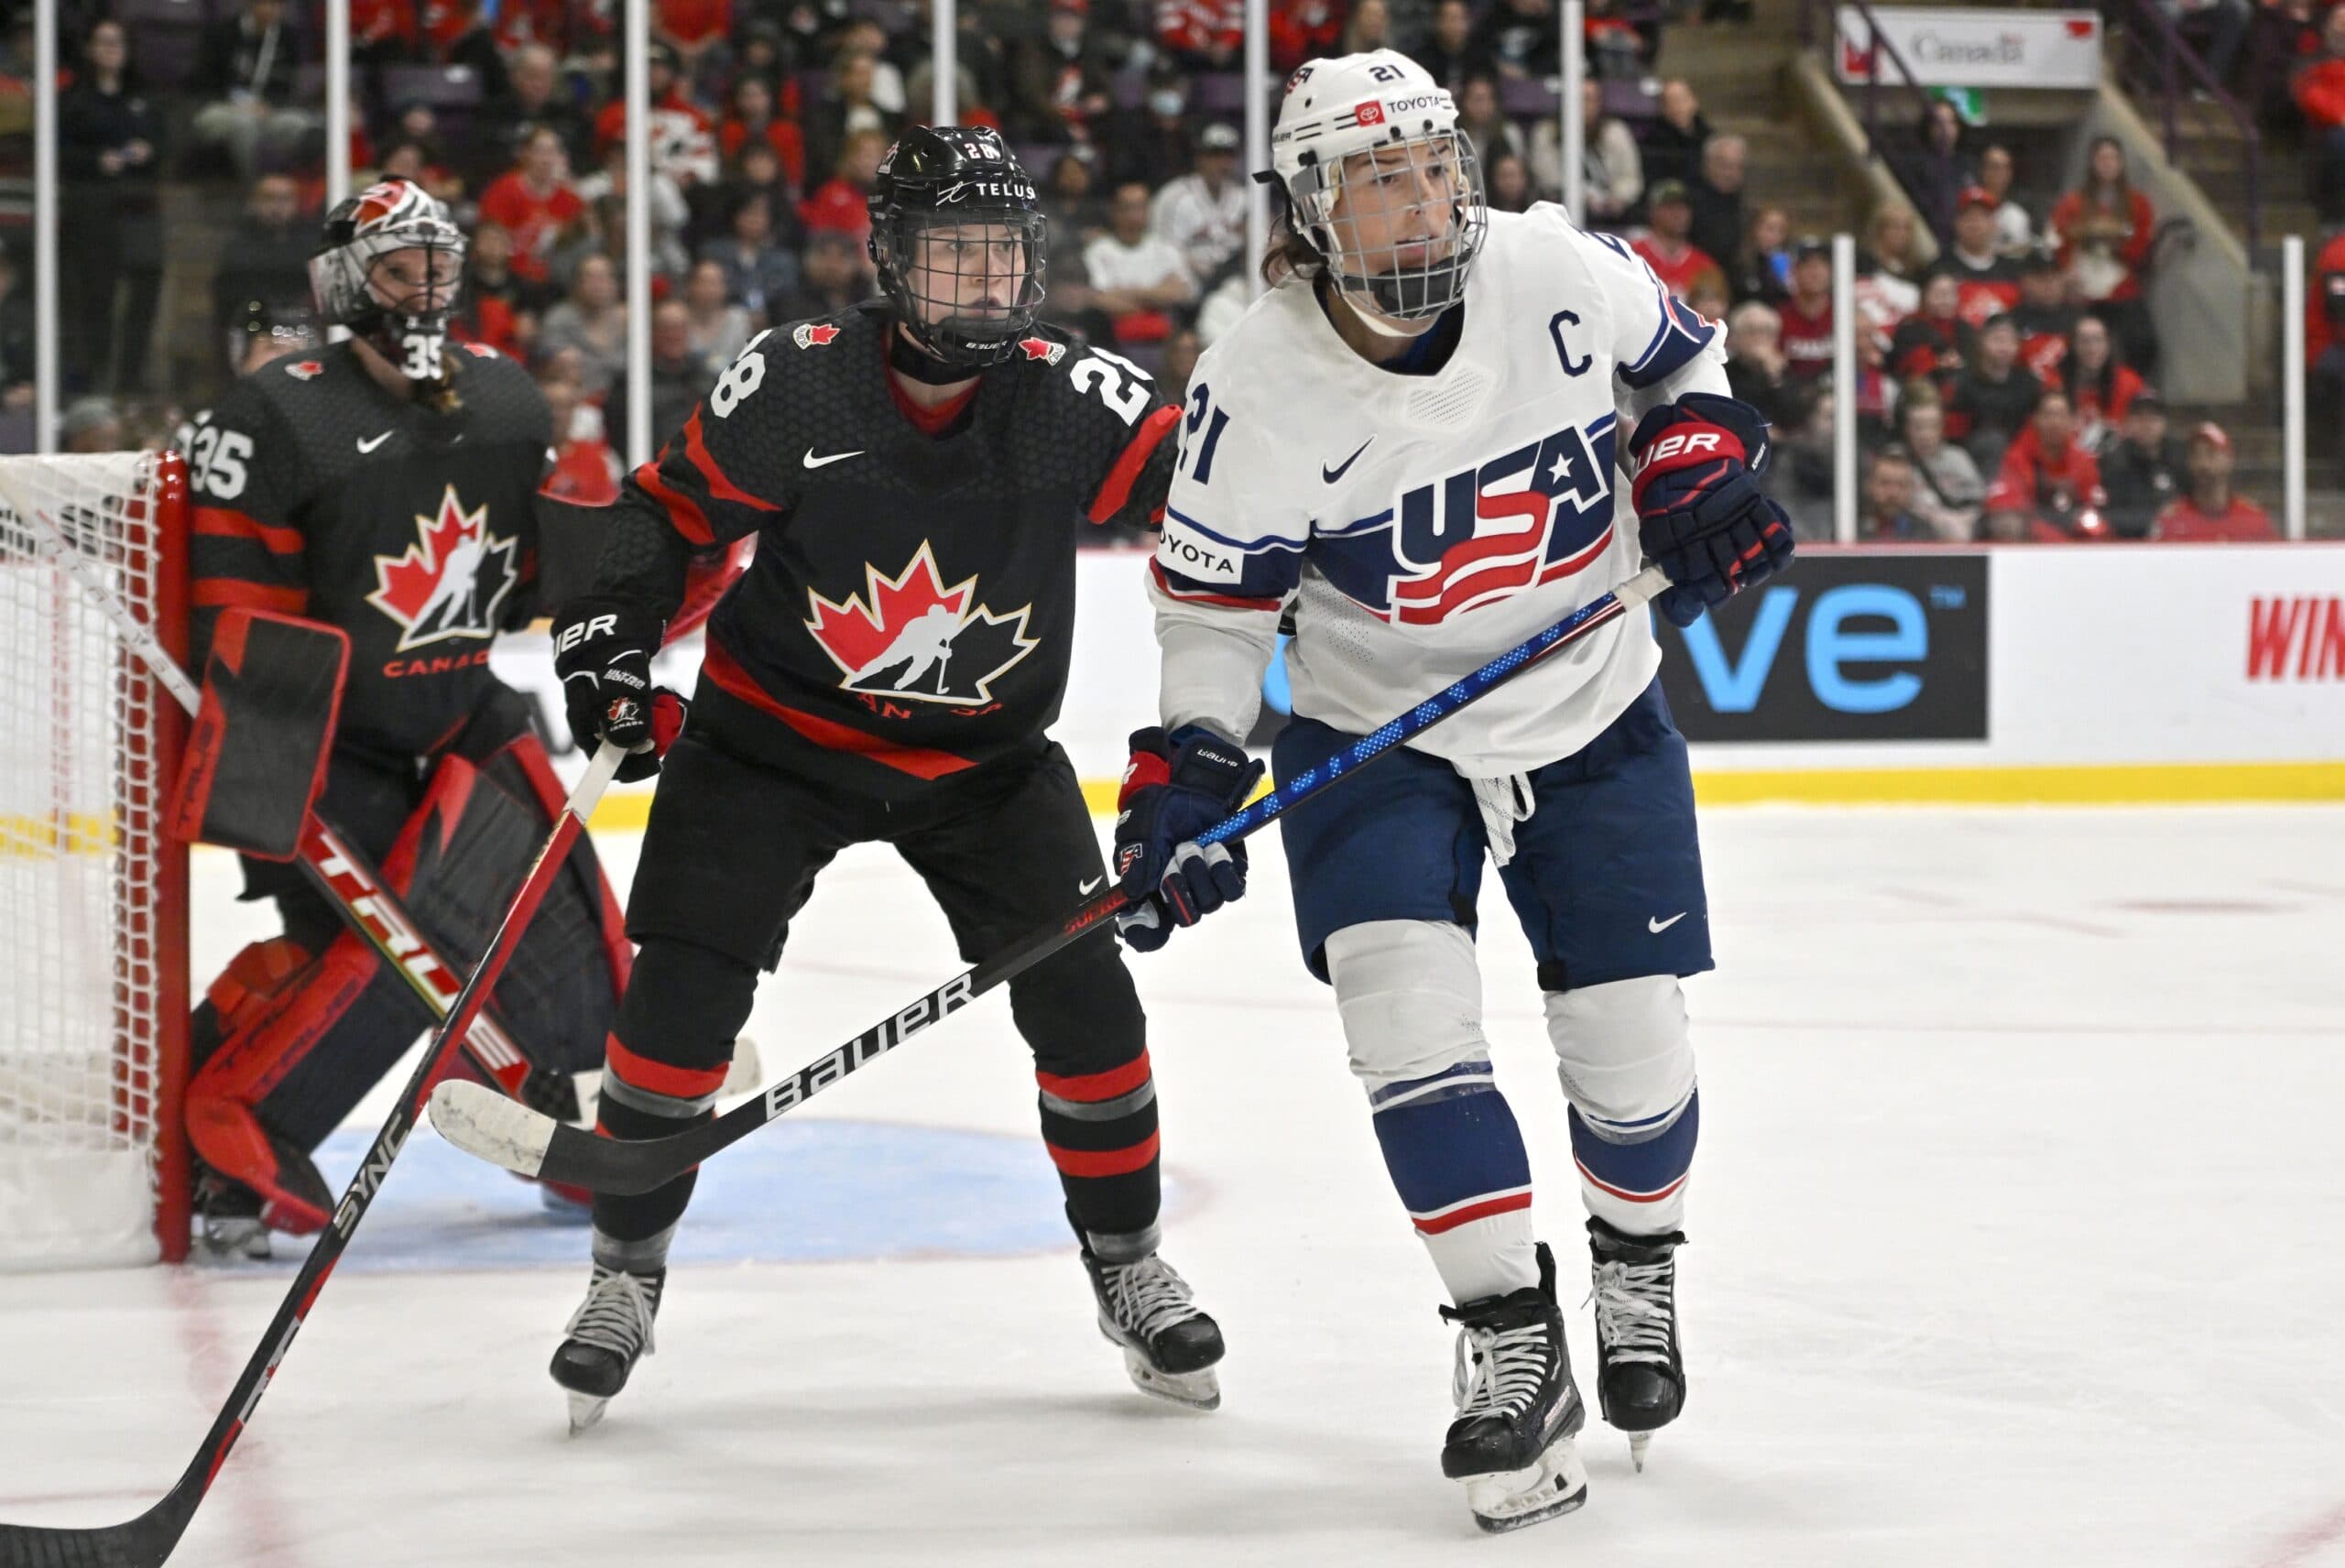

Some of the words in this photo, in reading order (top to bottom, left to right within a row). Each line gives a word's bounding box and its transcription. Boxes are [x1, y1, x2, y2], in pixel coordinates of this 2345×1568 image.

[1369, 64, 1406, 83] 21
[1387, 95, 1440, 114] TOYOTA
[975, 182, 1037, 200] TELUS
[400, 333, 445, 380] 35
[710, 328, 768, 419] 8
[1548, 310, 1594, 377] C
[1069, 344, 1154, 428] 2
[189, 425, 254, 501] 35
[1384, 422, 1610, 626] USA
[333, 1112, 411, 1240] SYNC
